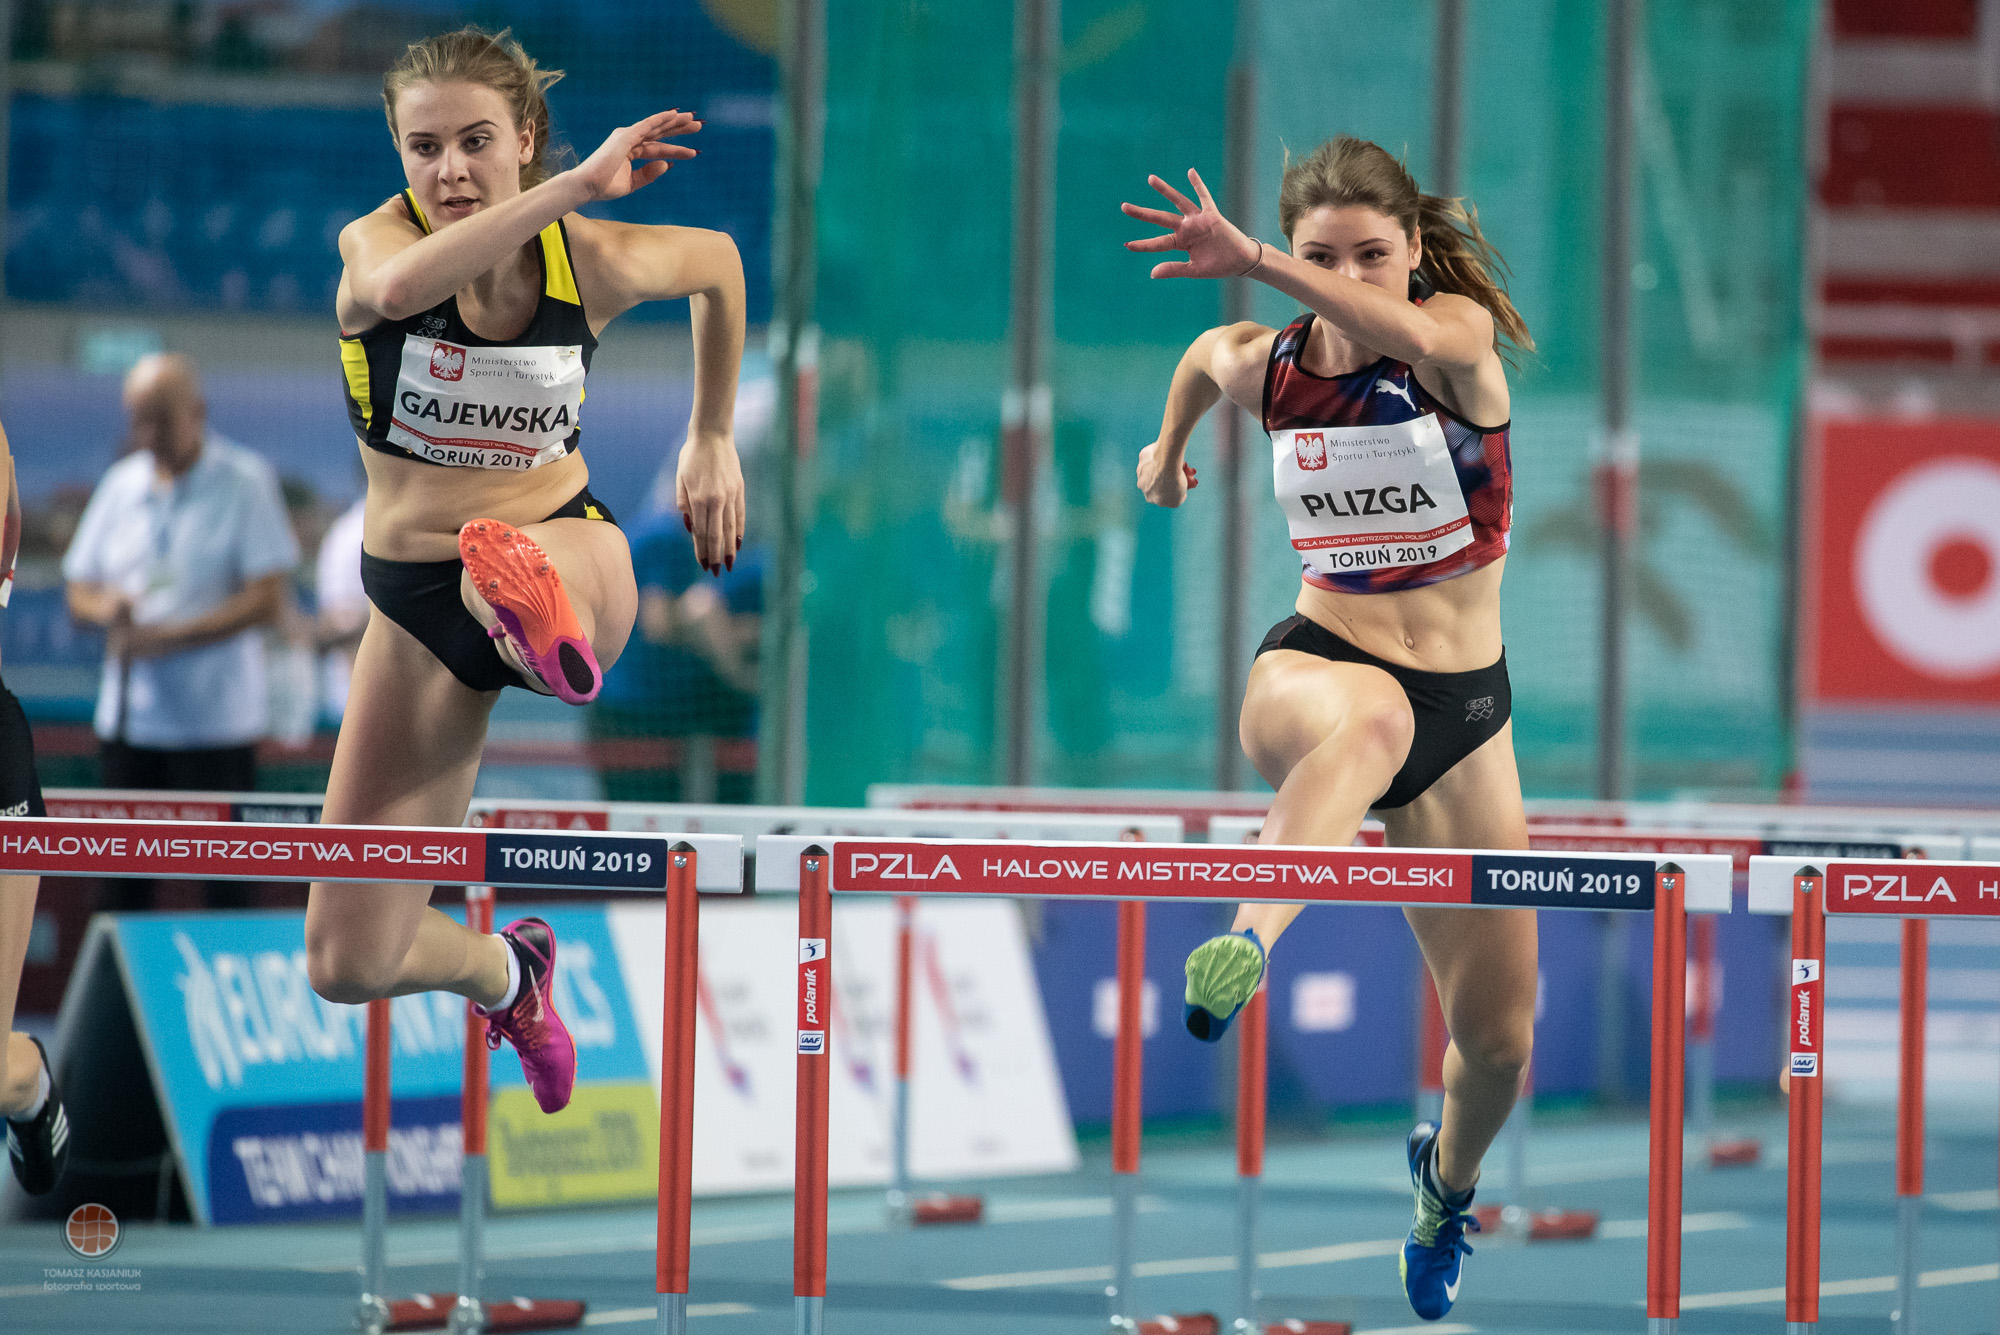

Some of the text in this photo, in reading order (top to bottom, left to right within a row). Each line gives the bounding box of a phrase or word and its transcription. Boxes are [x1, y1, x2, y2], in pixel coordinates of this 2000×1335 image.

[469, 368, 503, 378] Sportu
[471, 356, 537, 367] Ministerstwo
[400, 390, 569, 434] GAJEWSKA
[448, 439, 506, 448] MISTRZOSTWA
[1330, 437, 1390, 449] Ministerstwo
[1332, 452, 1363, 462] Sportu
[1373, 446, 1417, 460] Turystyki
[423, 444, 534, 469] TORUŃ 2019
[1300, 483, 1438, 518] PLIZGA
[1297, 540, 1318, 548] PZLA
[1319, 538, 1350, 546] HALOWE
[1351, 534, 1405, 543] MISTRZOSTWA
[1405, 533, 1431, 541] POLSKI
[1329, 544, 1438, 569] TORUŃ 2019
[2, 835, 467, 866] HALOWE MISTRZOSTWA POLSKI
[500, 845, 652, 873] TORUŃ 2019
[851, 852, 1453, 888] PZLA HALOWE MISTRZOSTWA POLSKI
[1487, 867, 1641, 895] TORUŃ 2019
[1843, 874, 2000, 903] PZLA H
[804, 968, 819, 1024] polanik
[1797, 990, 1812, 1047] polanik
[801, 1036, 821, 1044] IAAF
